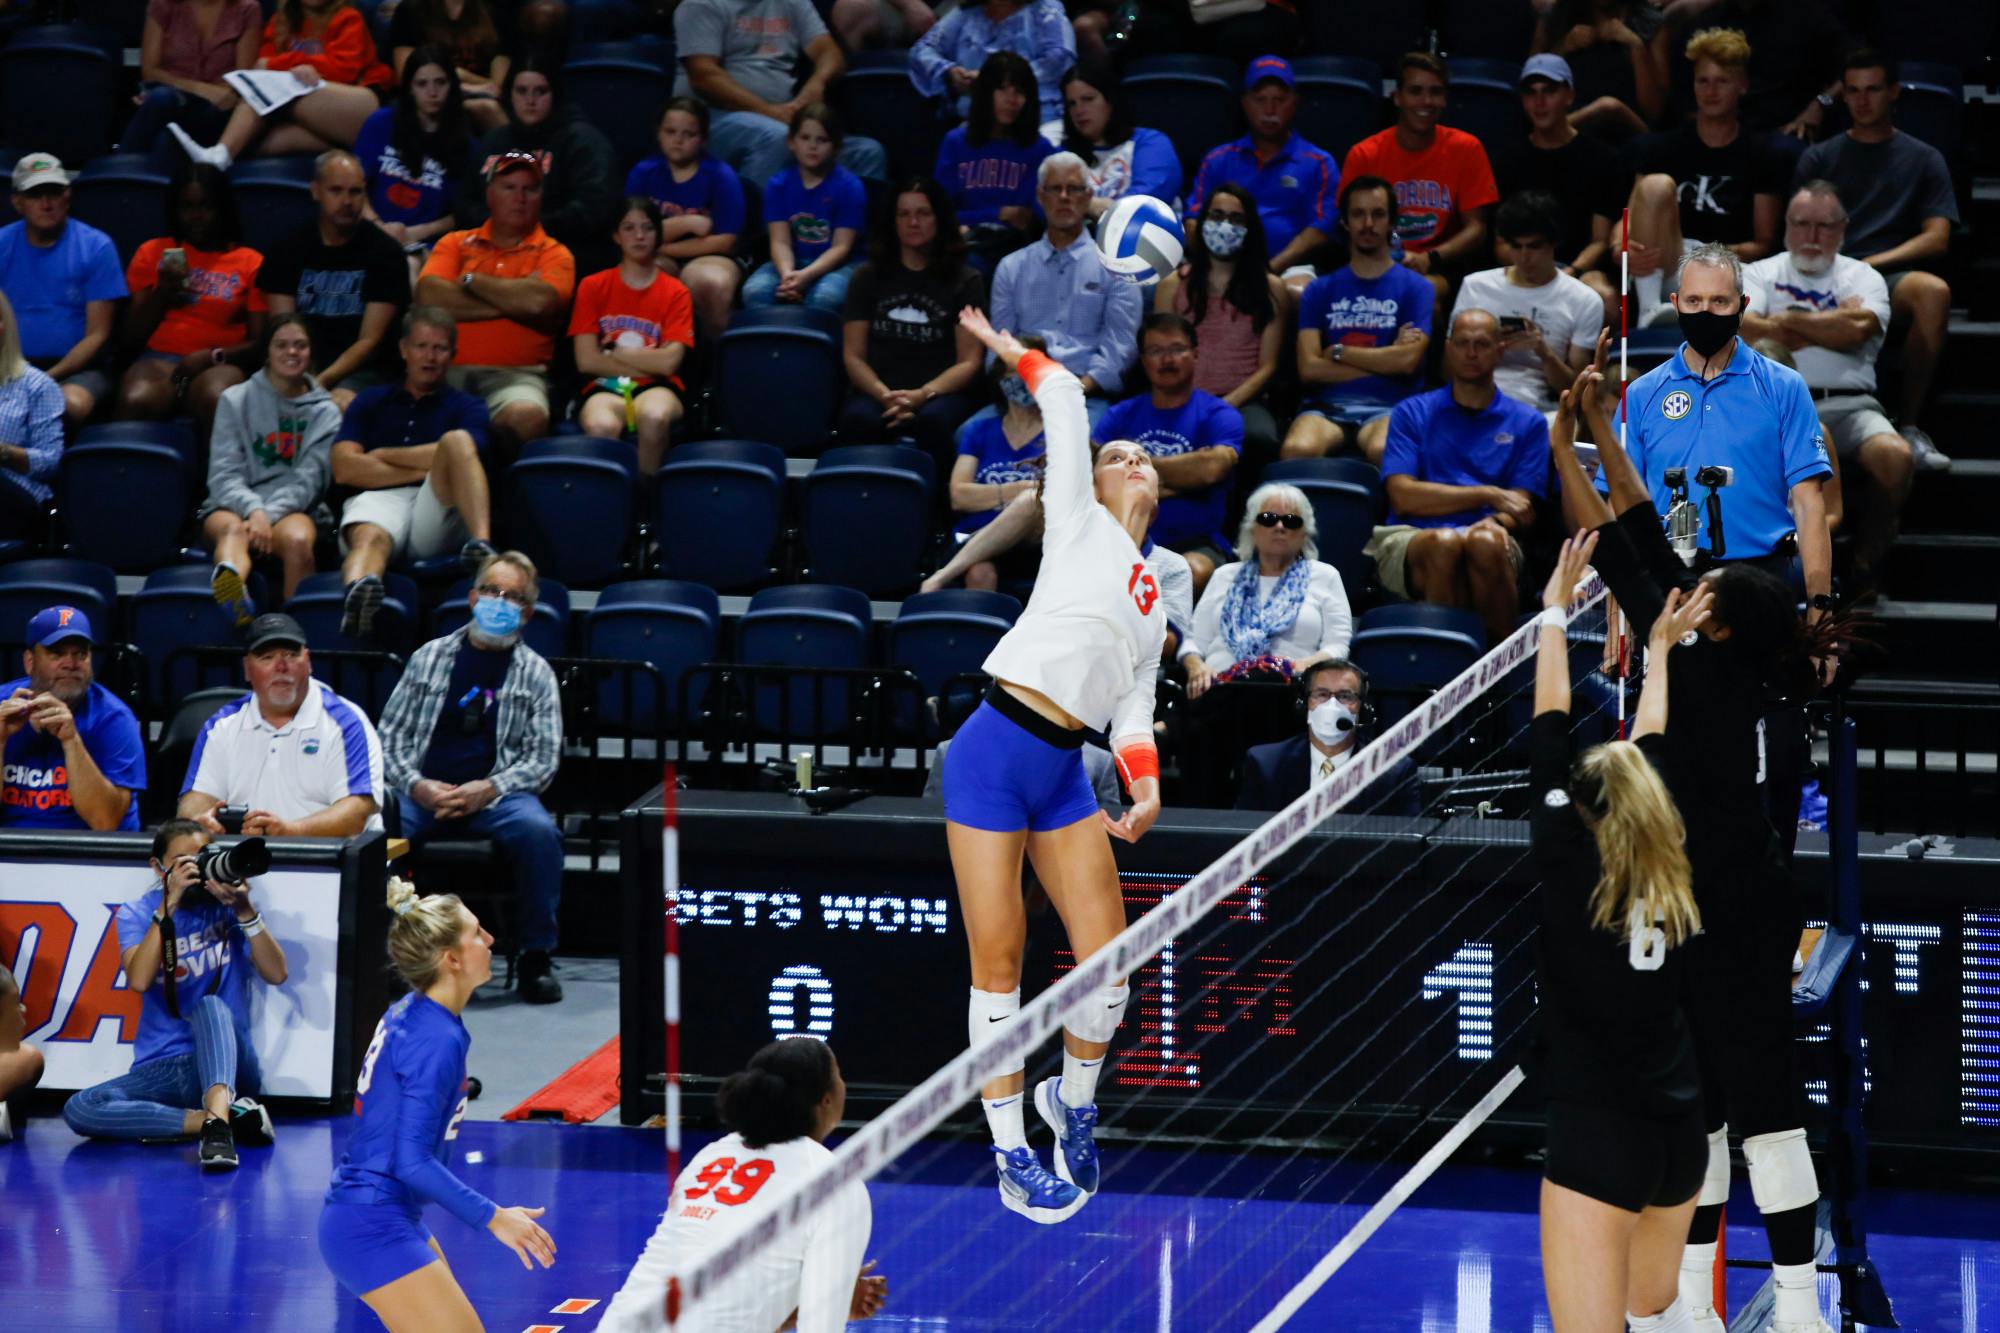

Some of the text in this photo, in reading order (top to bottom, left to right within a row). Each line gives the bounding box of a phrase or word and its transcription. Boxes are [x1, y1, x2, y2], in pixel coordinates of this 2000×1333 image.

[957, 158, 1024, 190] FLORID
[1395, 180, 1454, 211] ORIDA
[1328, 312, 1397, 330] TOGETHER
[1663, 393, 1692, 419] SEC
[1128, 562, 1159, 617] 13
[58, 608, 74, 627] F
[667, 889, 948, 934] SETS WON
[768, 964, 831, 1042] 0
[1422, 939, 1493, 1060] 1
[684, 1157, 776, 1206] 99
